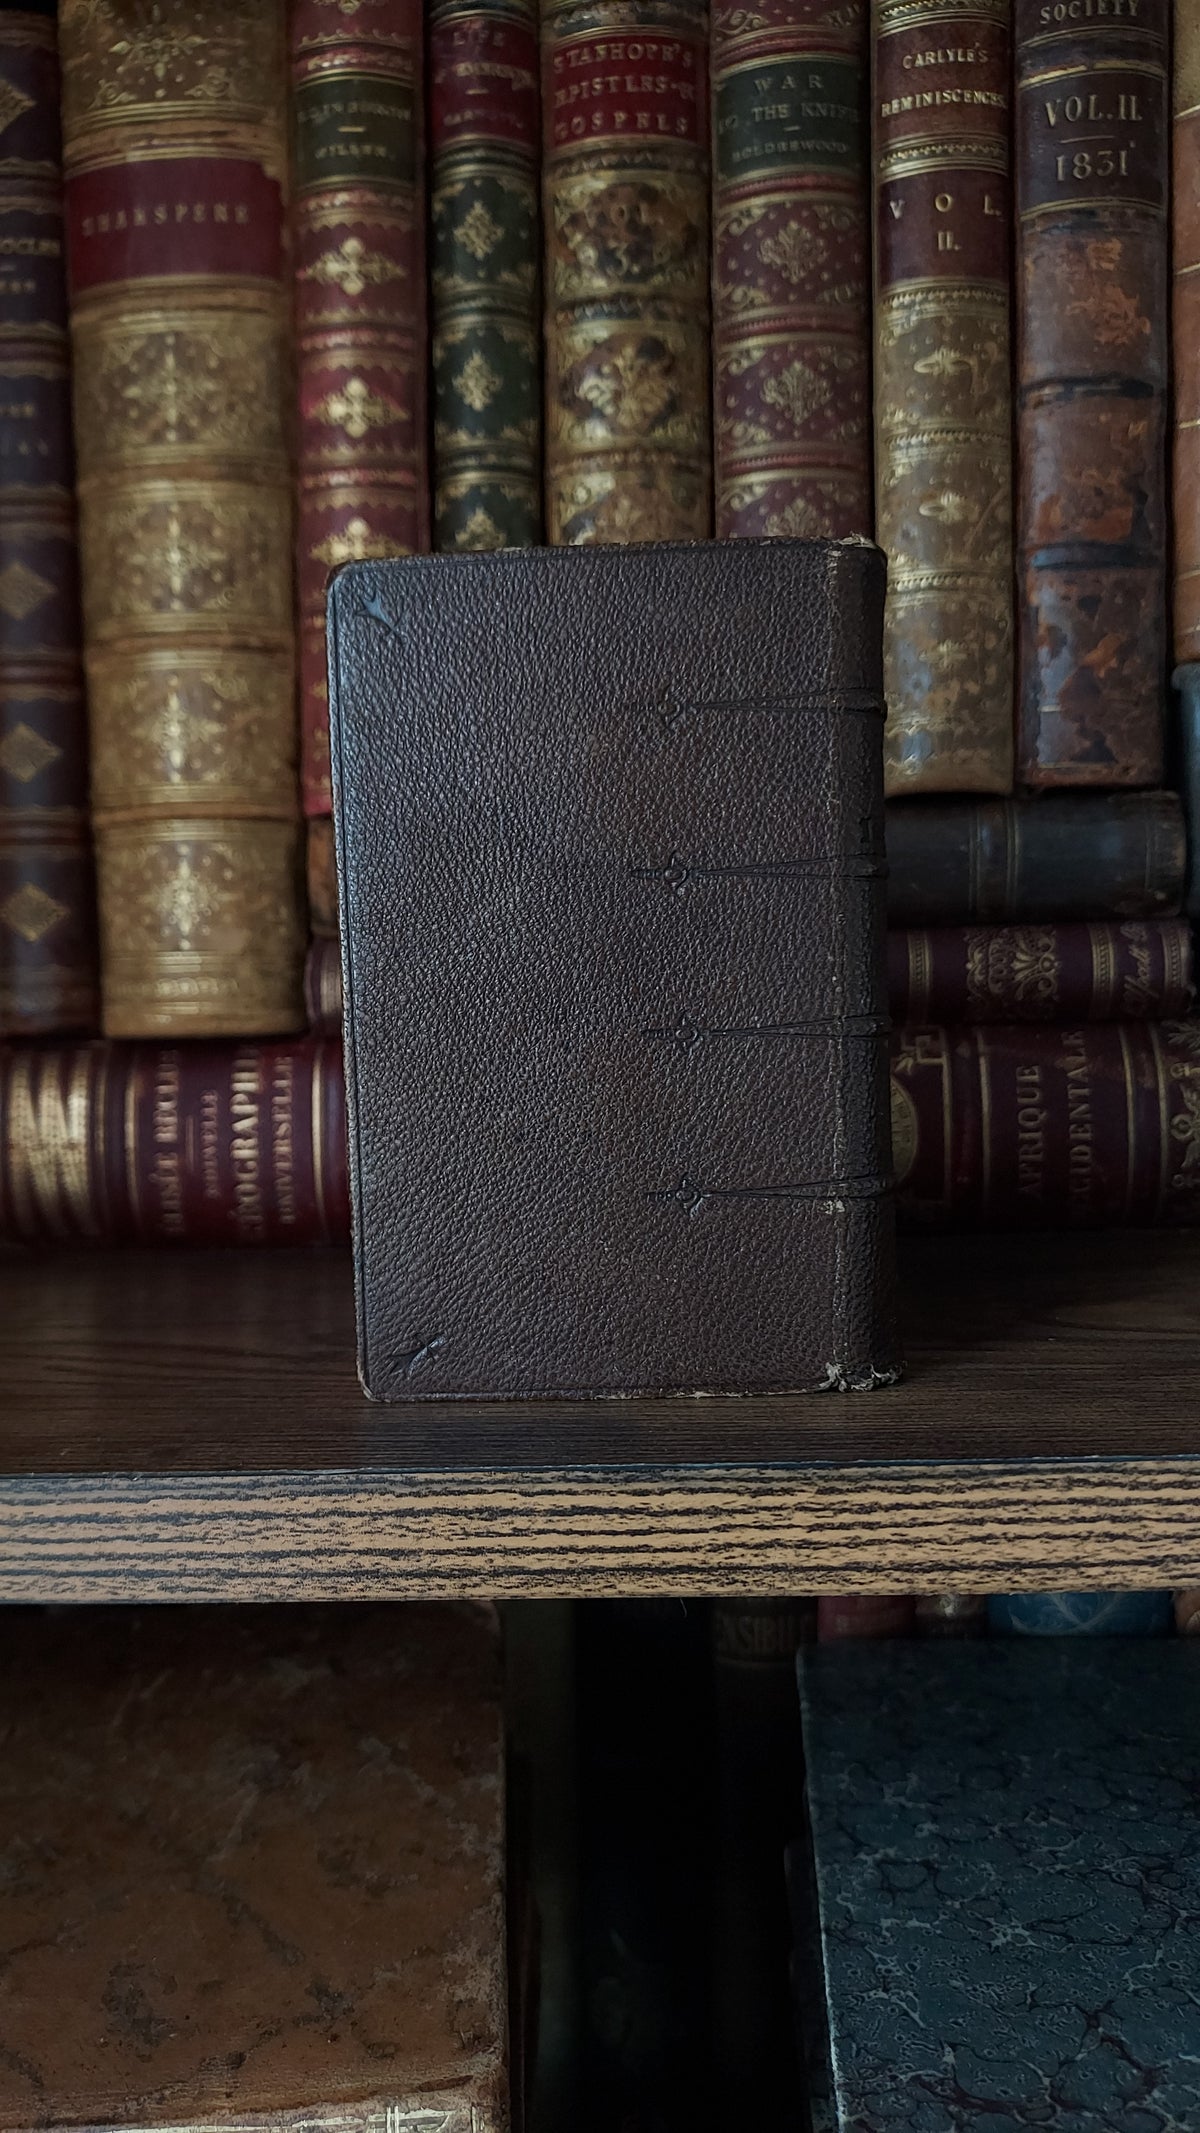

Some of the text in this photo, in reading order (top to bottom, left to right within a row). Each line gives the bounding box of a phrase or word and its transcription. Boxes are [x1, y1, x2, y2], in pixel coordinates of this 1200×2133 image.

[1040, 0, 1138, 24] SOCIETY
[903, 43, 989, 69] CARLYLE'S
[753, 74, 825, 97] WAR
[555, 110, 689, 141] GOSPELS
[751, 103, 791, 122] THE
[1056, 149, 1128, 182] 1831
[1015, 1064, 1047, 1199] AFRIQUE
